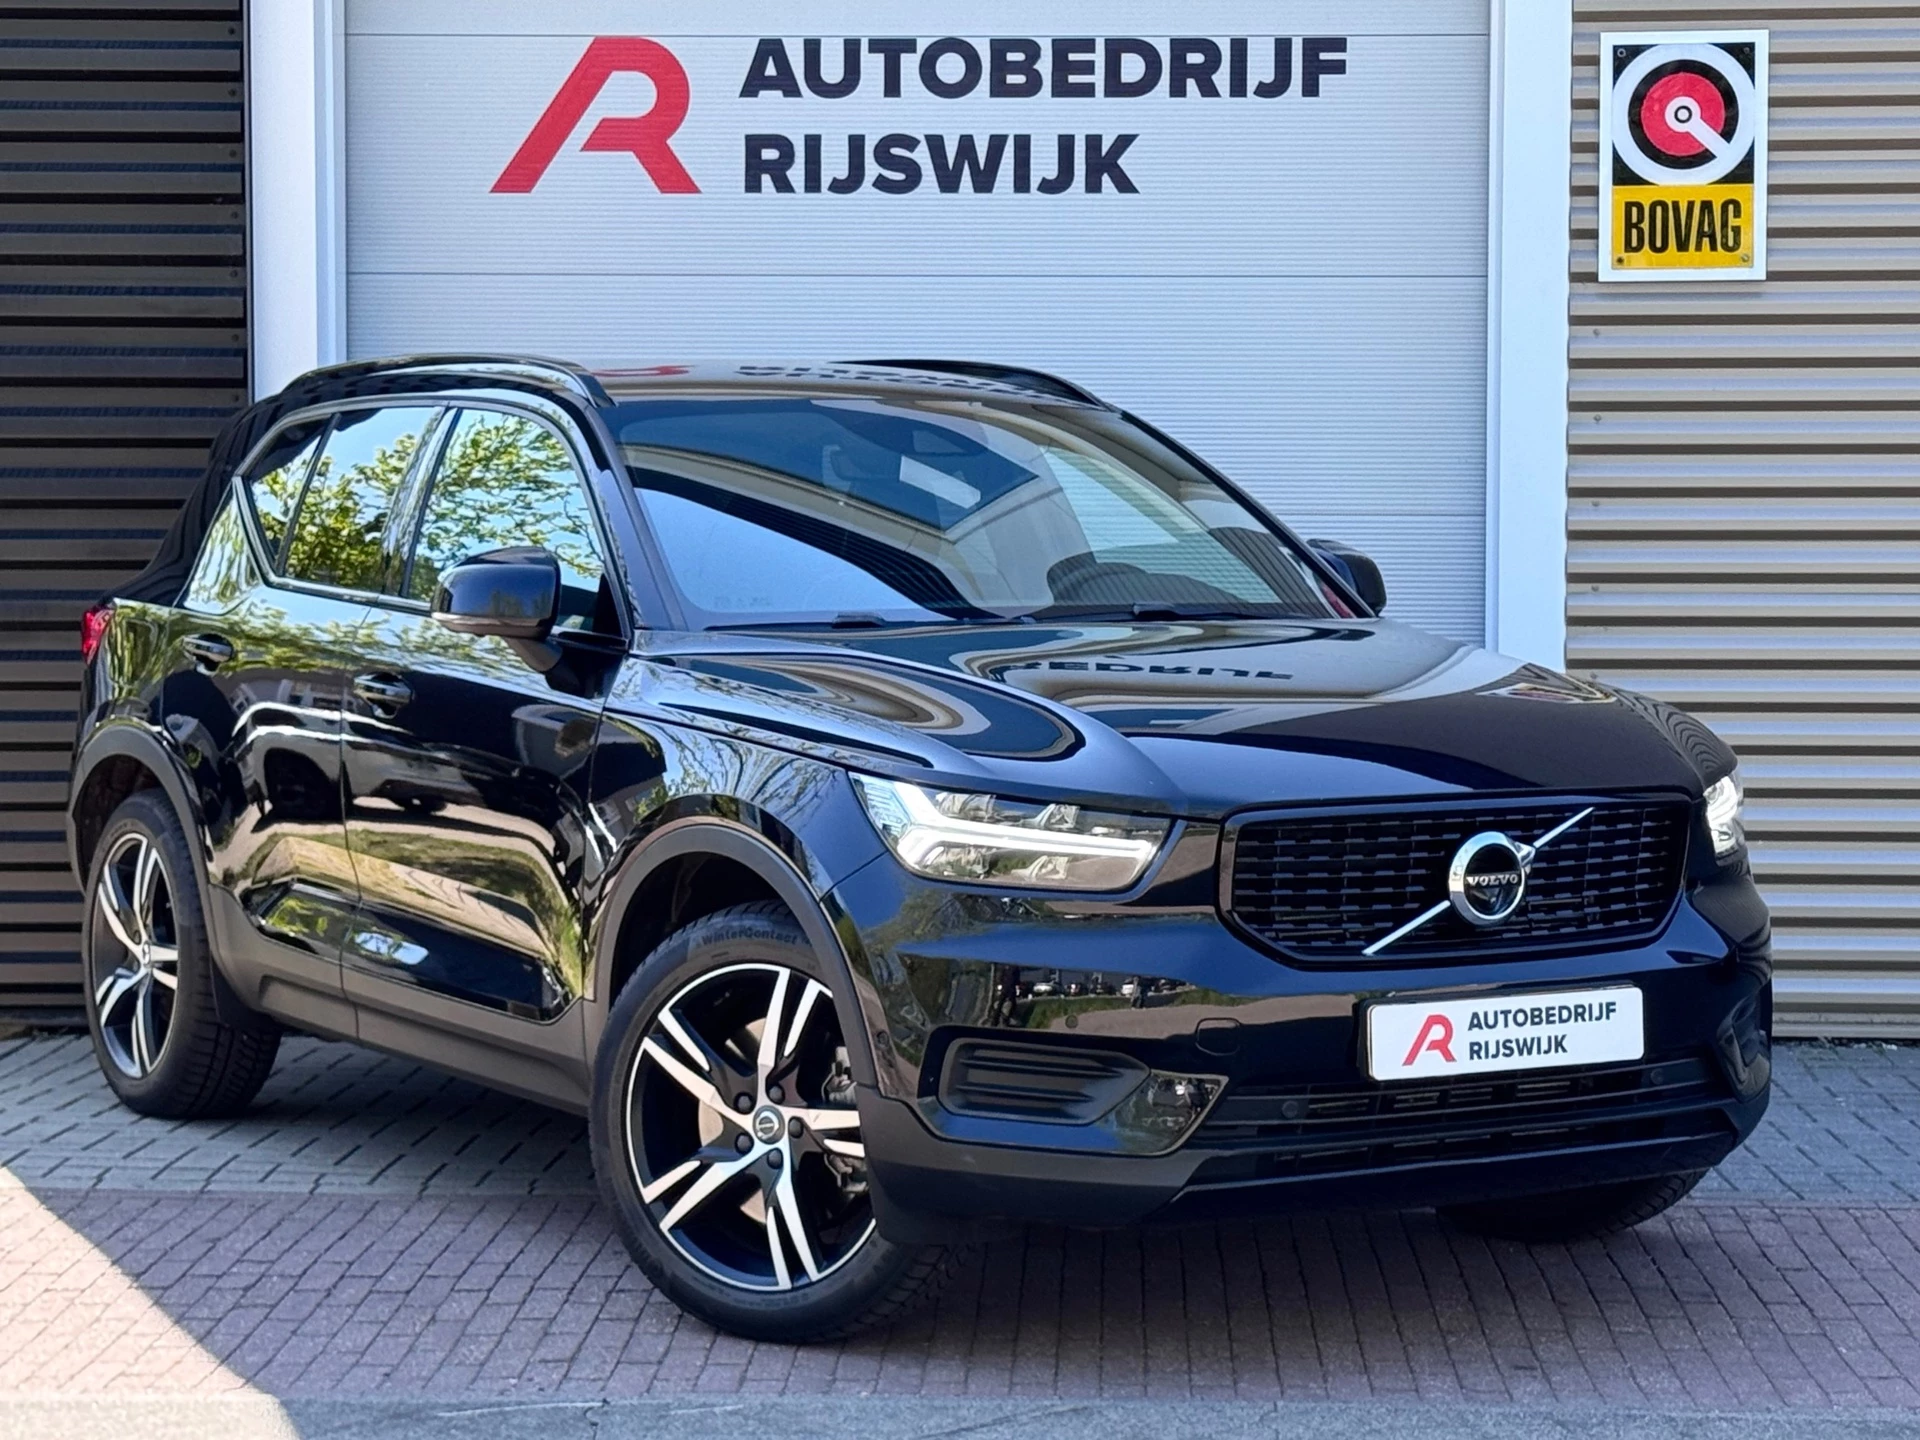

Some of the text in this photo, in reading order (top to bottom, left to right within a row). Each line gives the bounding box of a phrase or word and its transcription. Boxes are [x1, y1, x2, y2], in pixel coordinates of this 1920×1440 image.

[739, 37, 1348, 99] AUTOBEDRIJF
[744, 133, 1140, 195] RIJSWIJK
[1623, 198, 1742, 254] BOVAG
[1465, 873, 1519, 887] VOLVO
[701, 926, 798, 945] WinterContact
[1467, 1001, 1618, 1031] AUTOBEDRIJF
[1468, 1034, 1568, 1061] RIJSWIJK
